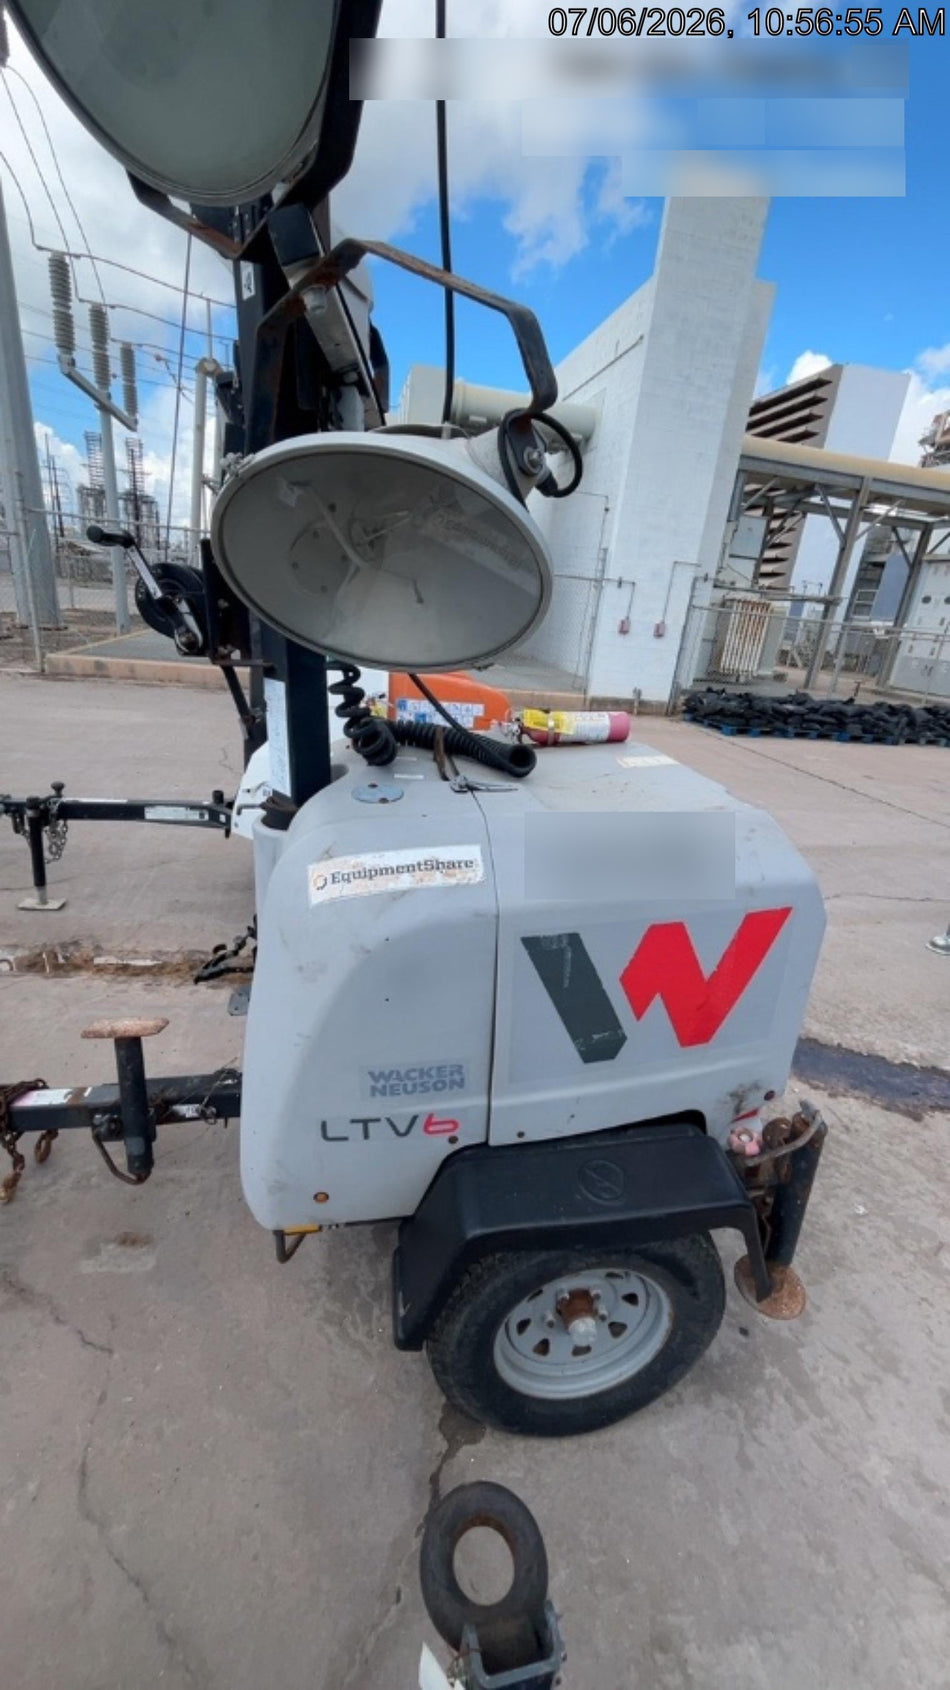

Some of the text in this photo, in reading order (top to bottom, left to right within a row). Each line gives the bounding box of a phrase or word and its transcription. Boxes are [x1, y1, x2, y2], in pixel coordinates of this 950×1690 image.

[331, 859, 474, 884] EquipmentShare
[368, 1064, 464, 1083] WACKER
[369, 1078, 465, 1097] NEUSON
[320, 1113, 459, 1142] LTV6
